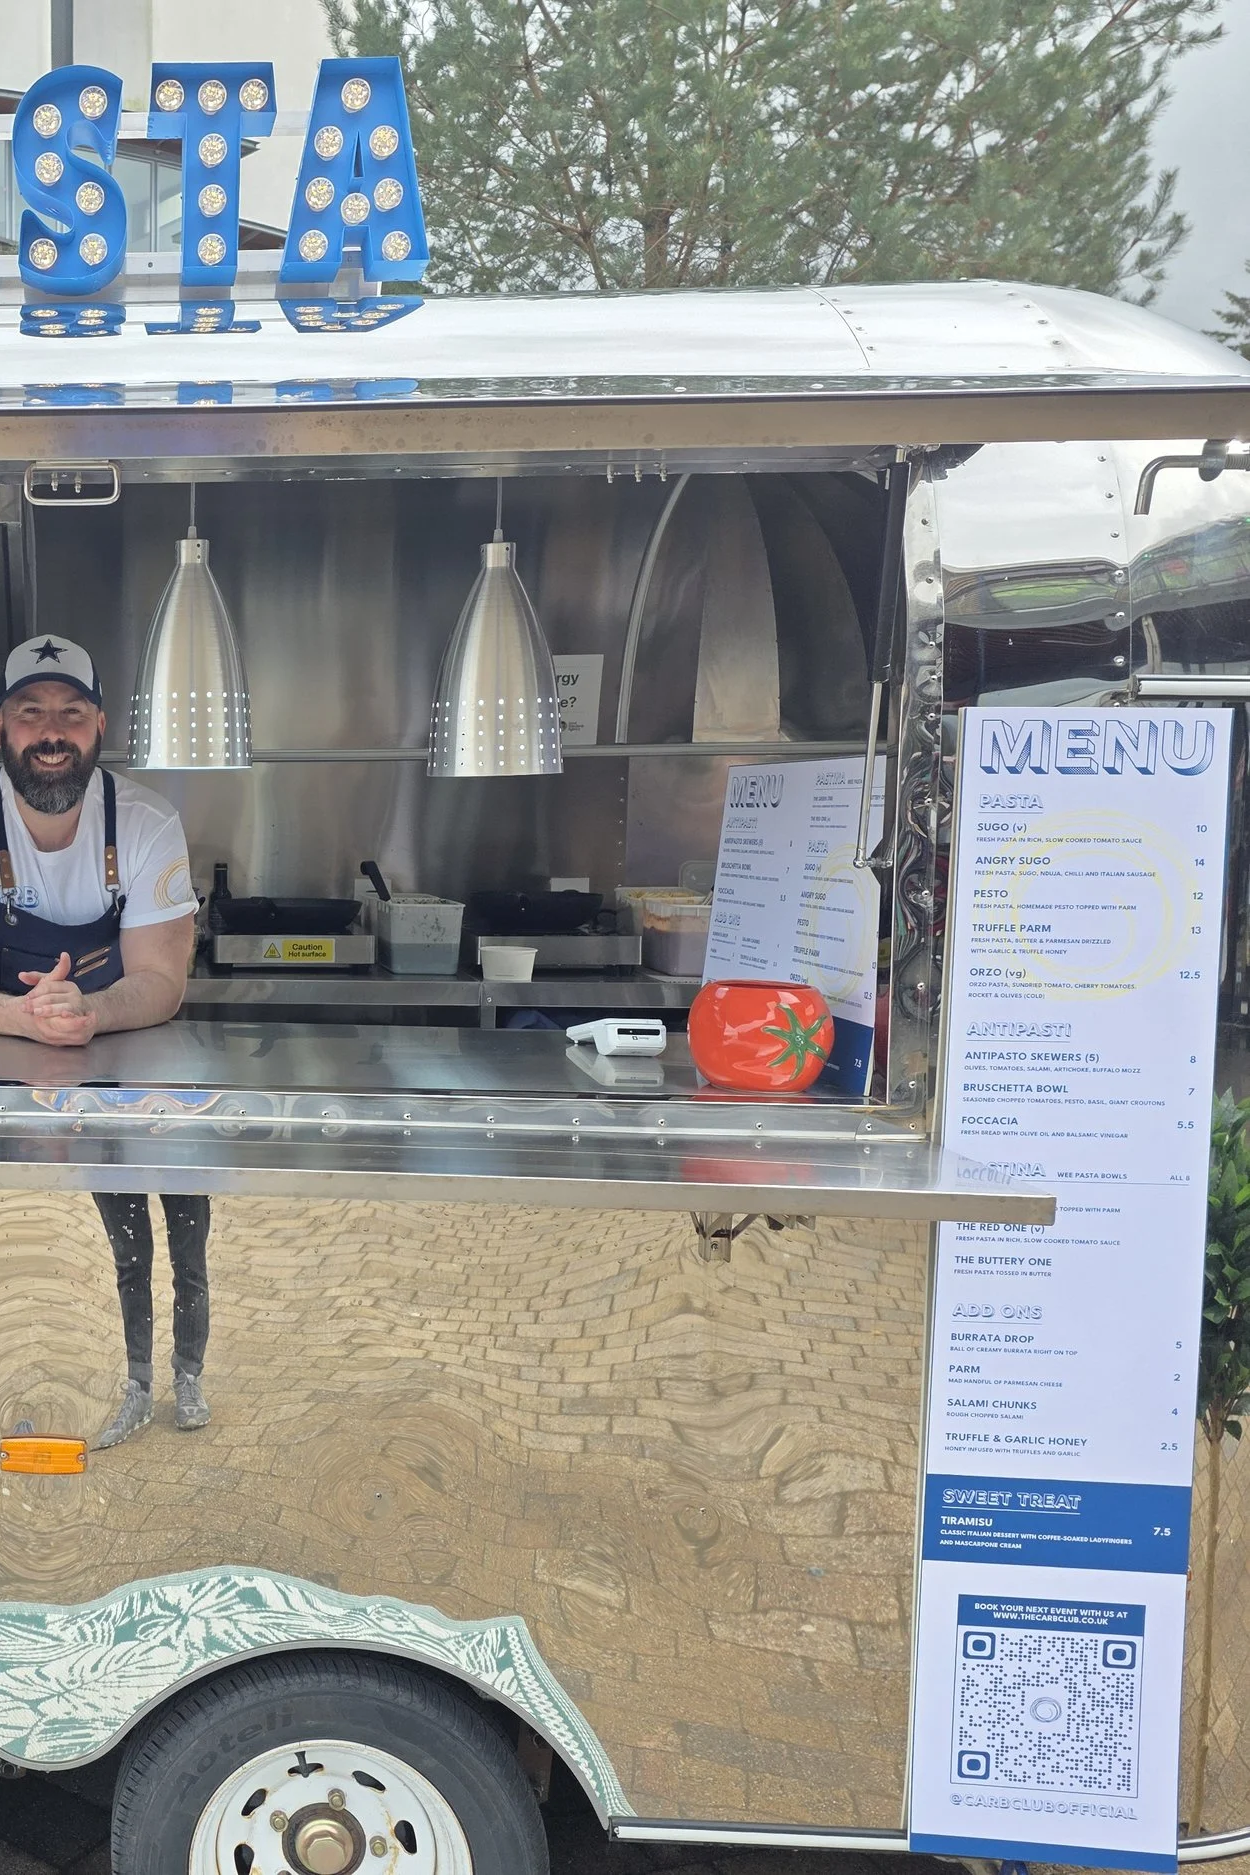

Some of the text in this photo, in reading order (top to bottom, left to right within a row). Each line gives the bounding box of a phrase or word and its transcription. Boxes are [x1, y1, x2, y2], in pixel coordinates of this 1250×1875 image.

[979, 719, 1214, 776] MENU
[730, 774, 784, 808] MENU
[980, 794, 1043, 808] PASTA
[977, 823, 1026, 833] SUGO (v)
[972, 924, 1015, 932] TRUFFLE
[970, 968, 1026, 978] ORZO (vg)
[966, 1022, 1071, 1037] ANTIPASTI
[965, 1051, 1099, 1063] ANTIPASTO SKEWERS (5)
[963, 1083, 1032, 1092] BRUSCHETTA
[962, 1116, 1018, 1124] FOCCACIA
[986, 1162, 1046, 1177] STINA
[980, 1223, 1000, 1232] RED
[1004, 1224, 1027, 1232] ONE
[978, 1256, 1024, 1264] BUTTERY
[1028, 1258, 1051, 1266] ONE
[952, 1304, 1042, 1319] ADD ONS
[951, 1333, 1034, 1342] BURRATA DROP
[949, 1364, 979, 1373] PARM
[947, 1398, 1036, 1409] SALAMI CHUNKS
[946, 1432, 989, 1441] TRUFFLE
[1004, 1435, 1044, 1444] GARLIC
[1048, 1437, 1087, 1446] HONEY
[942, 1488, 1081, 1509] SWEET TREAT
[941, 1516, 992, 1526] TIRAMISU
[1154, 1527, 1170, 1535] 7.5
[975, 1603, 998, 1611] BOOK
[1000, 1604, 1024, 1612] YOUR
[1026, 1606, 1049, 1614] NEXT
[1050, 1607, 1078, 1615] EVENT
[1080, 1608, 1102, 1617] WITH
[993, 1612, 1108, 1625] WWW.THECARBCLUB.CO.UK
[951, 1794, 1137, 1820] @CARBCLUBOFFICIAL
